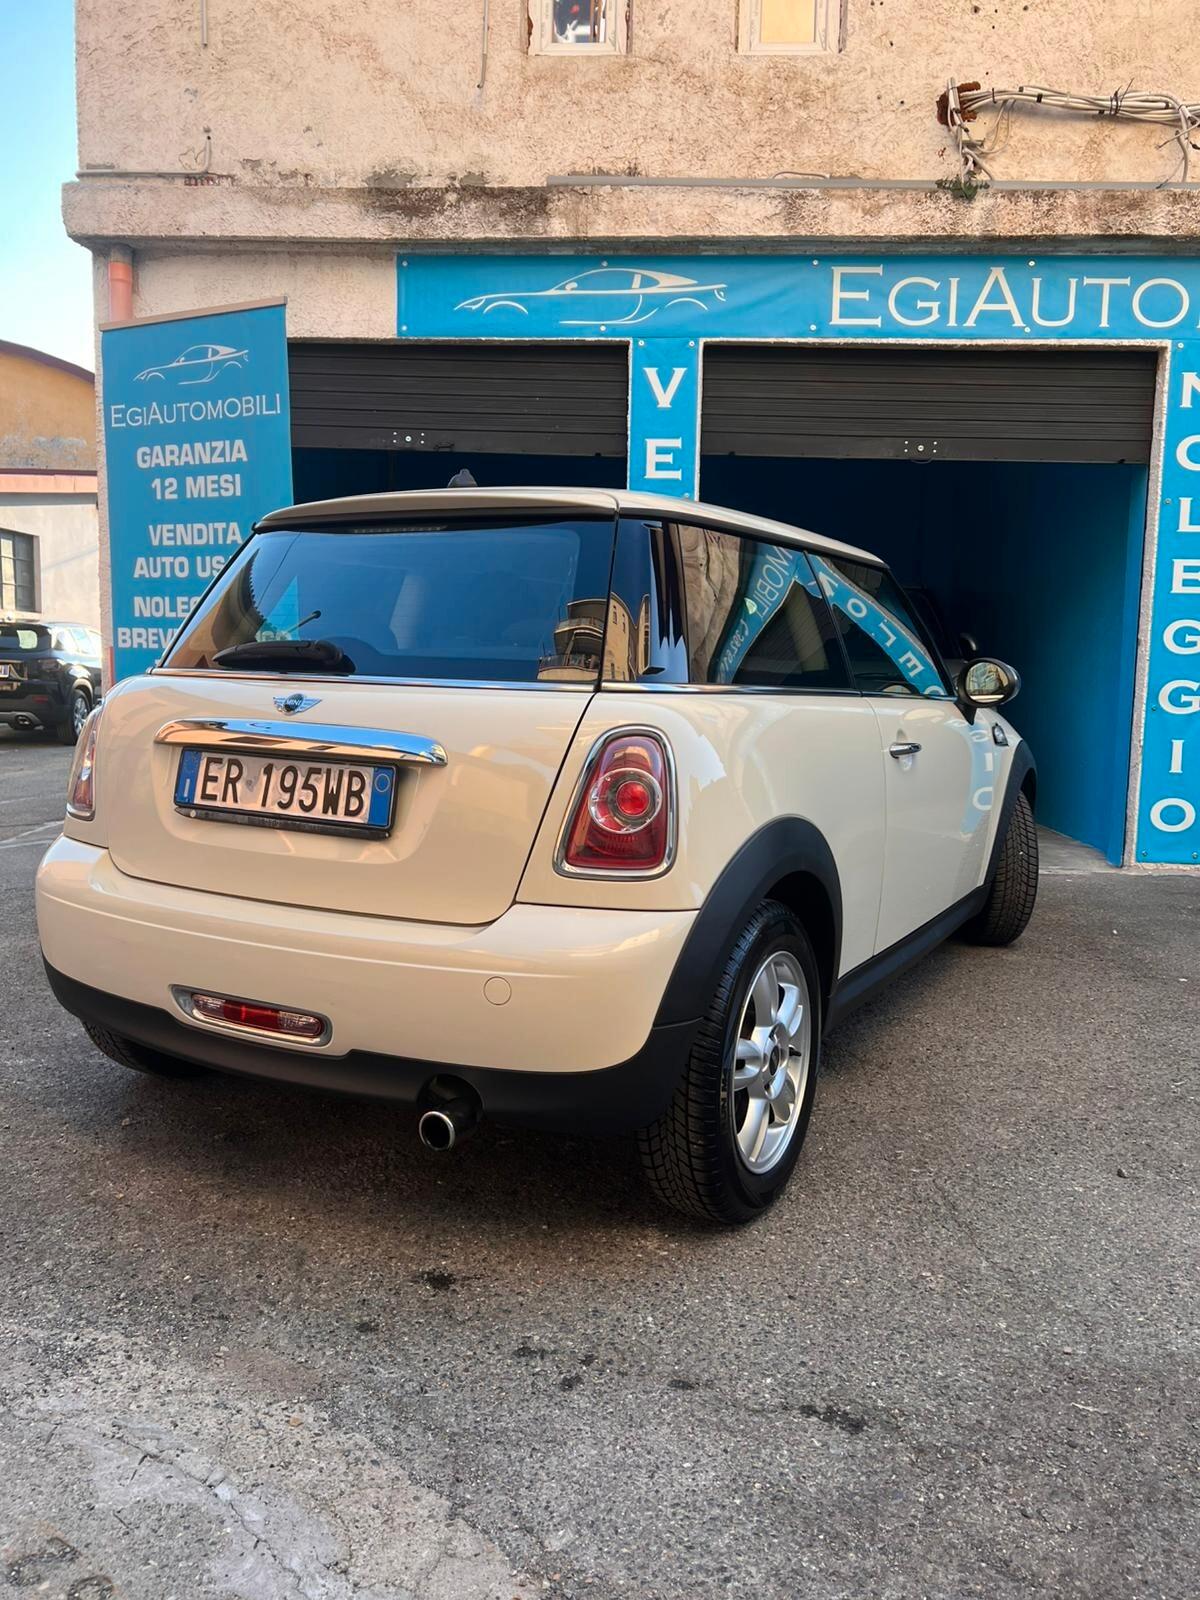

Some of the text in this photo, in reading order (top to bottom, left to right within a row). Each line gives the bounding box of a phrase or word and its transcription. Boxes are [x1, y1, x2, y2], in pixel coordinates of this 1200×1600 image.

[829, 264, 1200, 328] EGIAUTO
[136, 439, 248, 469] GARANZIA
[151, 473, 241, 500] 12 MESI
[148, 522, 243, 546] VENDITA
[133, 555, 231, 578] AUTO US
[117, 627, 178, 649] BREV
[201, 757, 367, 818] ER 195WB
